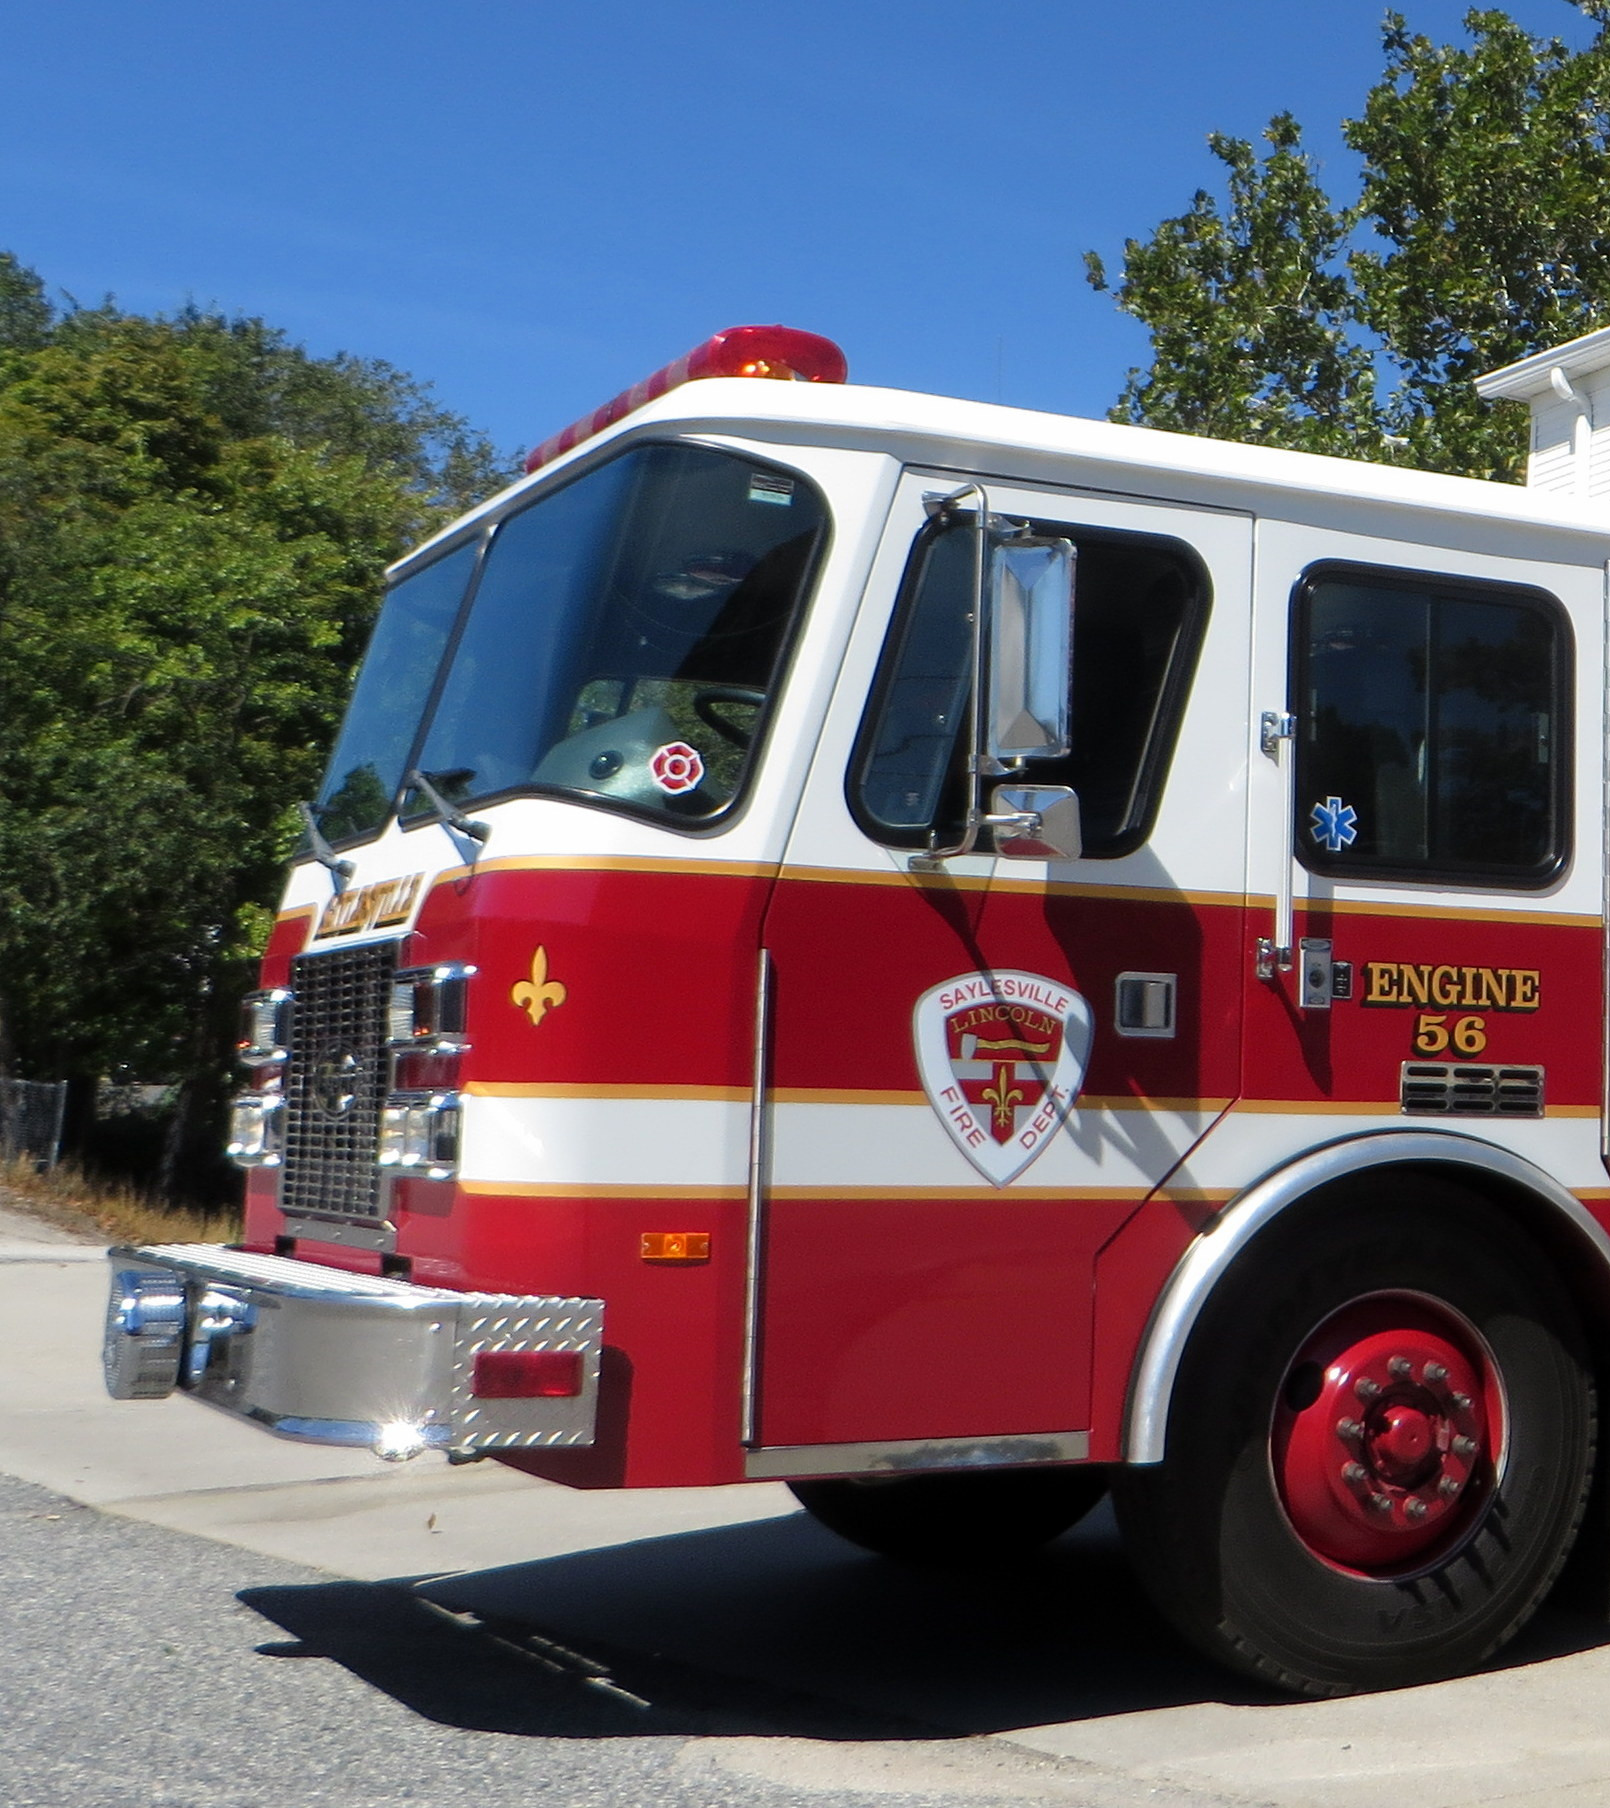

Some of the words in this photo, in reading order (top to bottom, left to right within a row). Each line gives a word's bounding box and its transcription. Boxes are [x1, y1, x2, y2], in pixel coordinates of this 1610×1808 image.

[939, 978, 1069, 1015] SAYLESVILLE
[1363, 961, 1540, 1010] ENGINE
[951, 1005, 1056, 1034] LINCOLN
[1414, 1014, 1487, 1056] 56
[940, 1085, 986, 1149] FIRE
[1019, 1084, 1070, 1150] DEPT.
